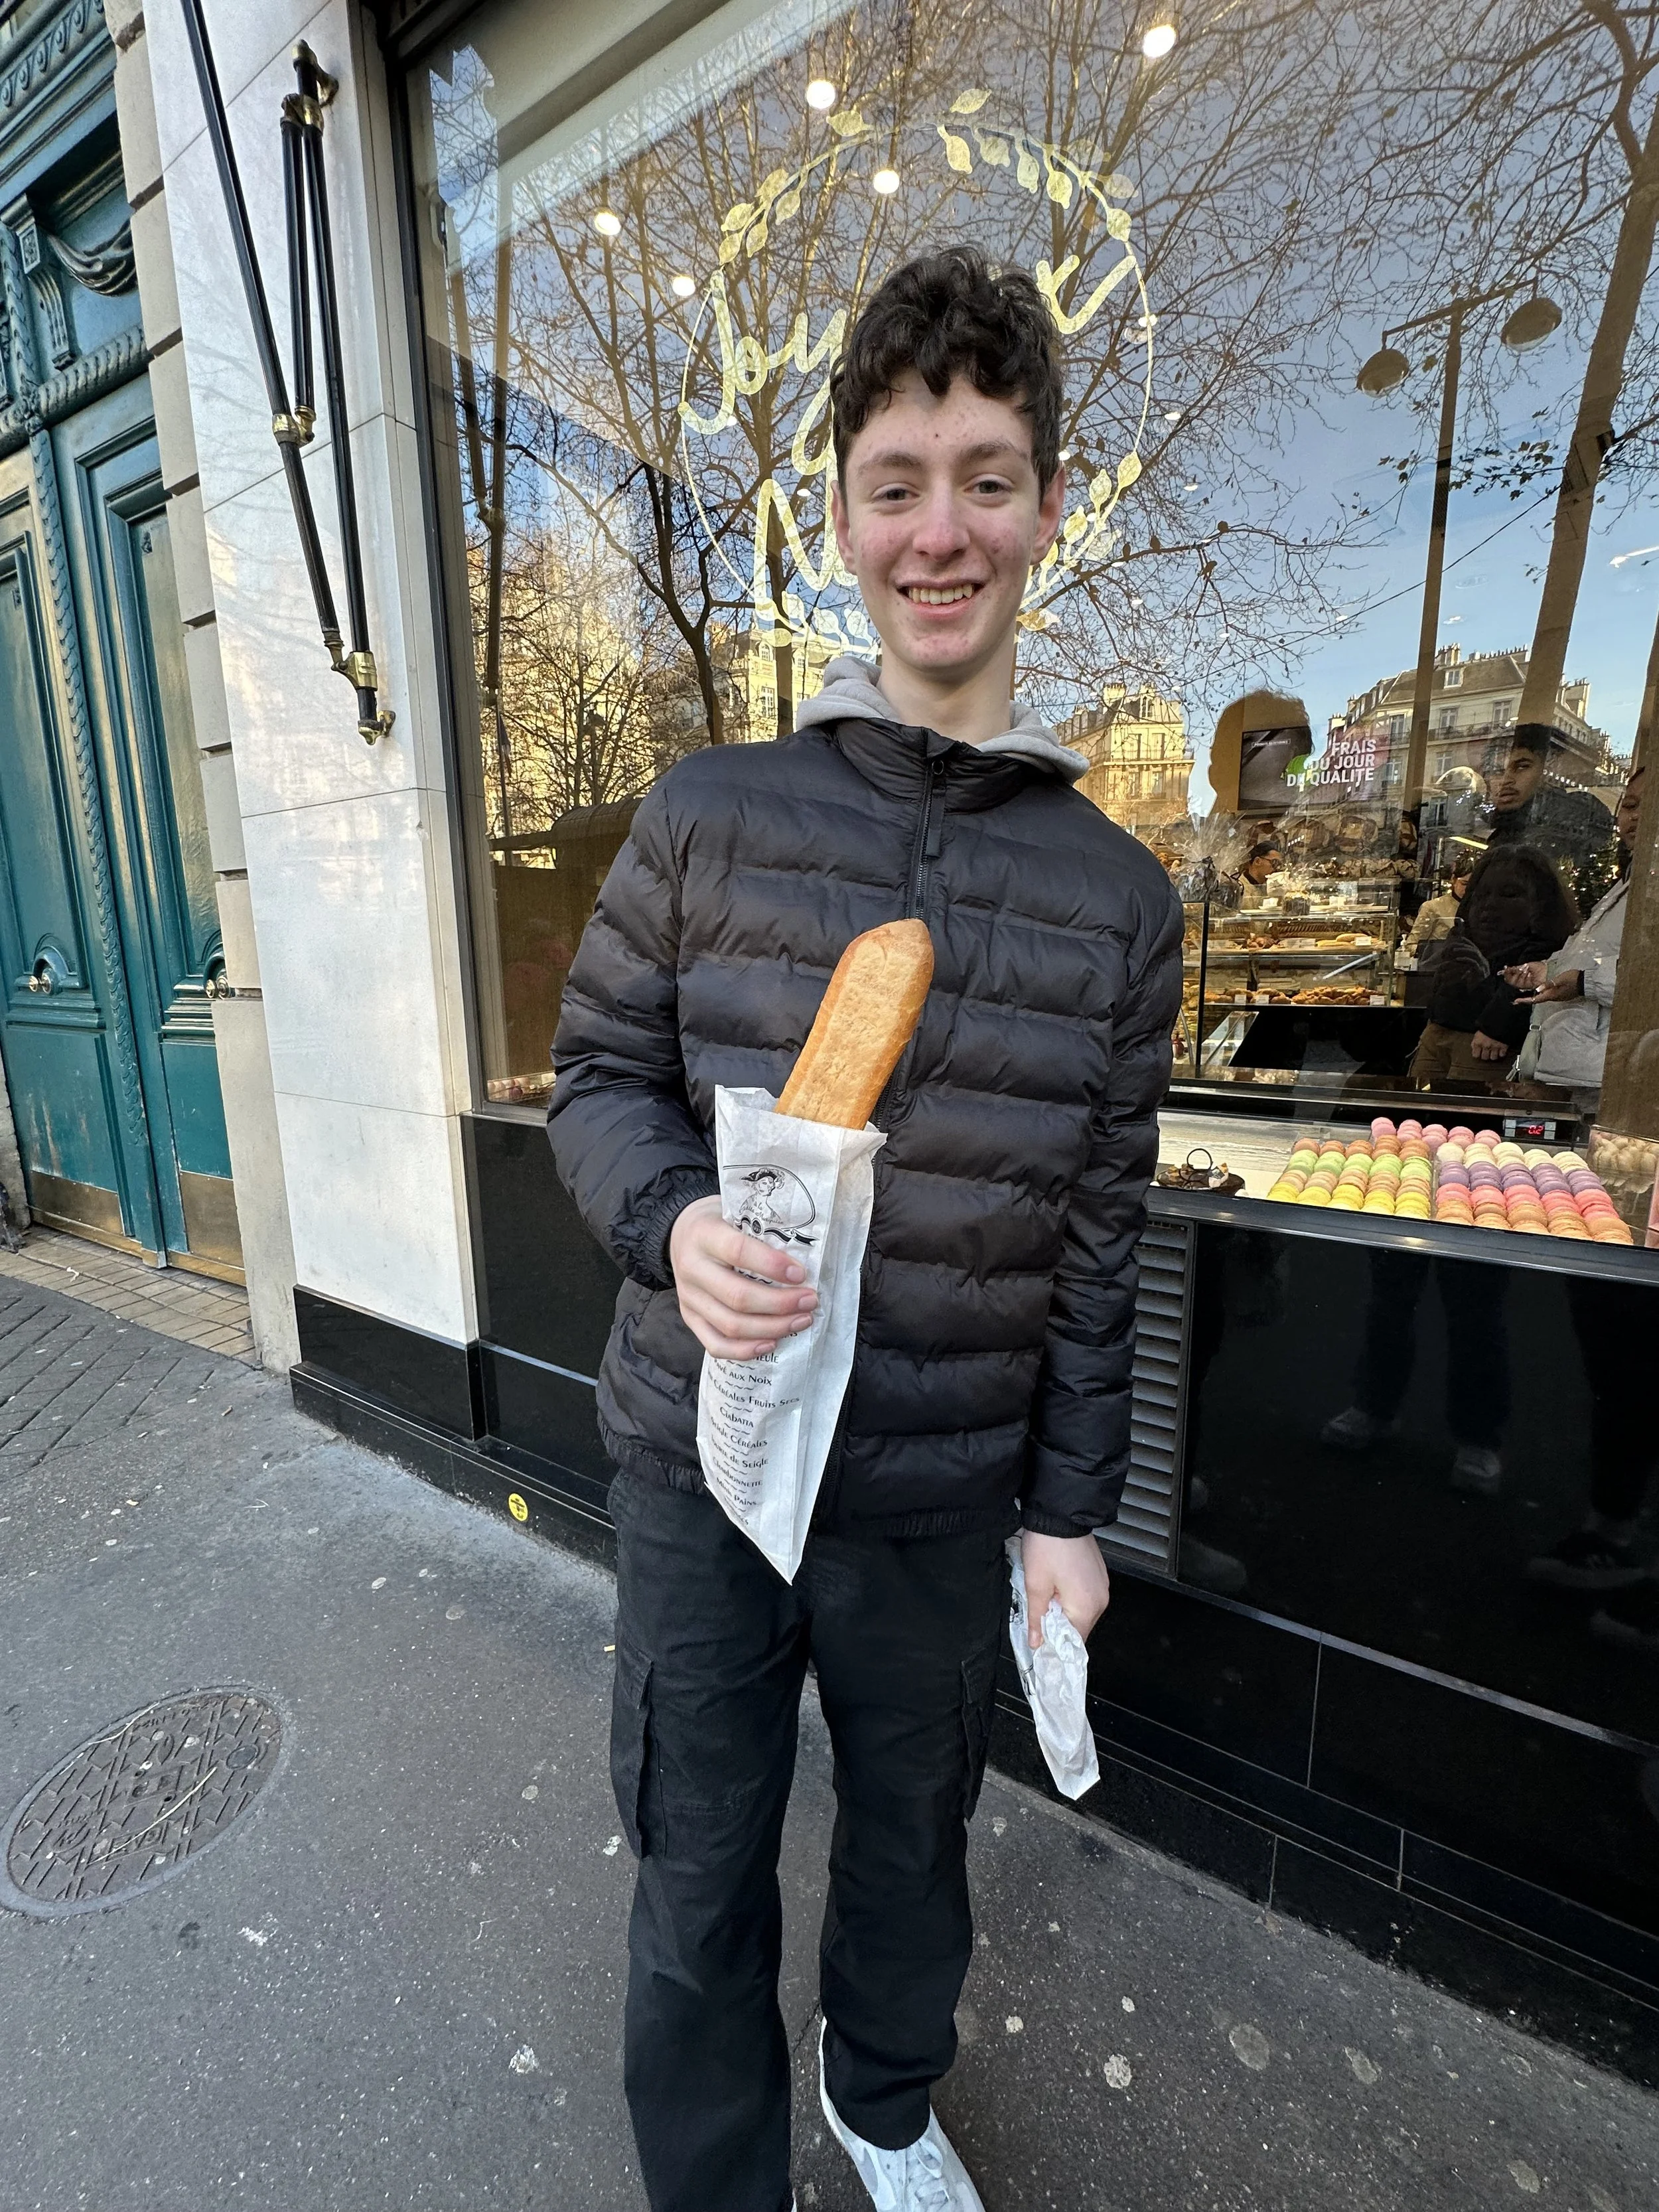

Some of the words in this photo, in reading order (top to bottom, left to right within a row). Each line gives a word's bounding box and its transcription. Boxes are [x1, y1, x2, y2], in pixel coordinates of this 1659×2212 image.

[1331, 739, 1376, 755] FRAIS
[1312, 757, 1331, 771] DU
[1334, 753, 1375, 770] JOUR
[748, 1374, 772, 1386] Noix
[749, 1396, 776, 1408] Fruits
[719, 1406, 754, 1428] Ciabatta
[742, 1458, 769, 1468] Seigle
